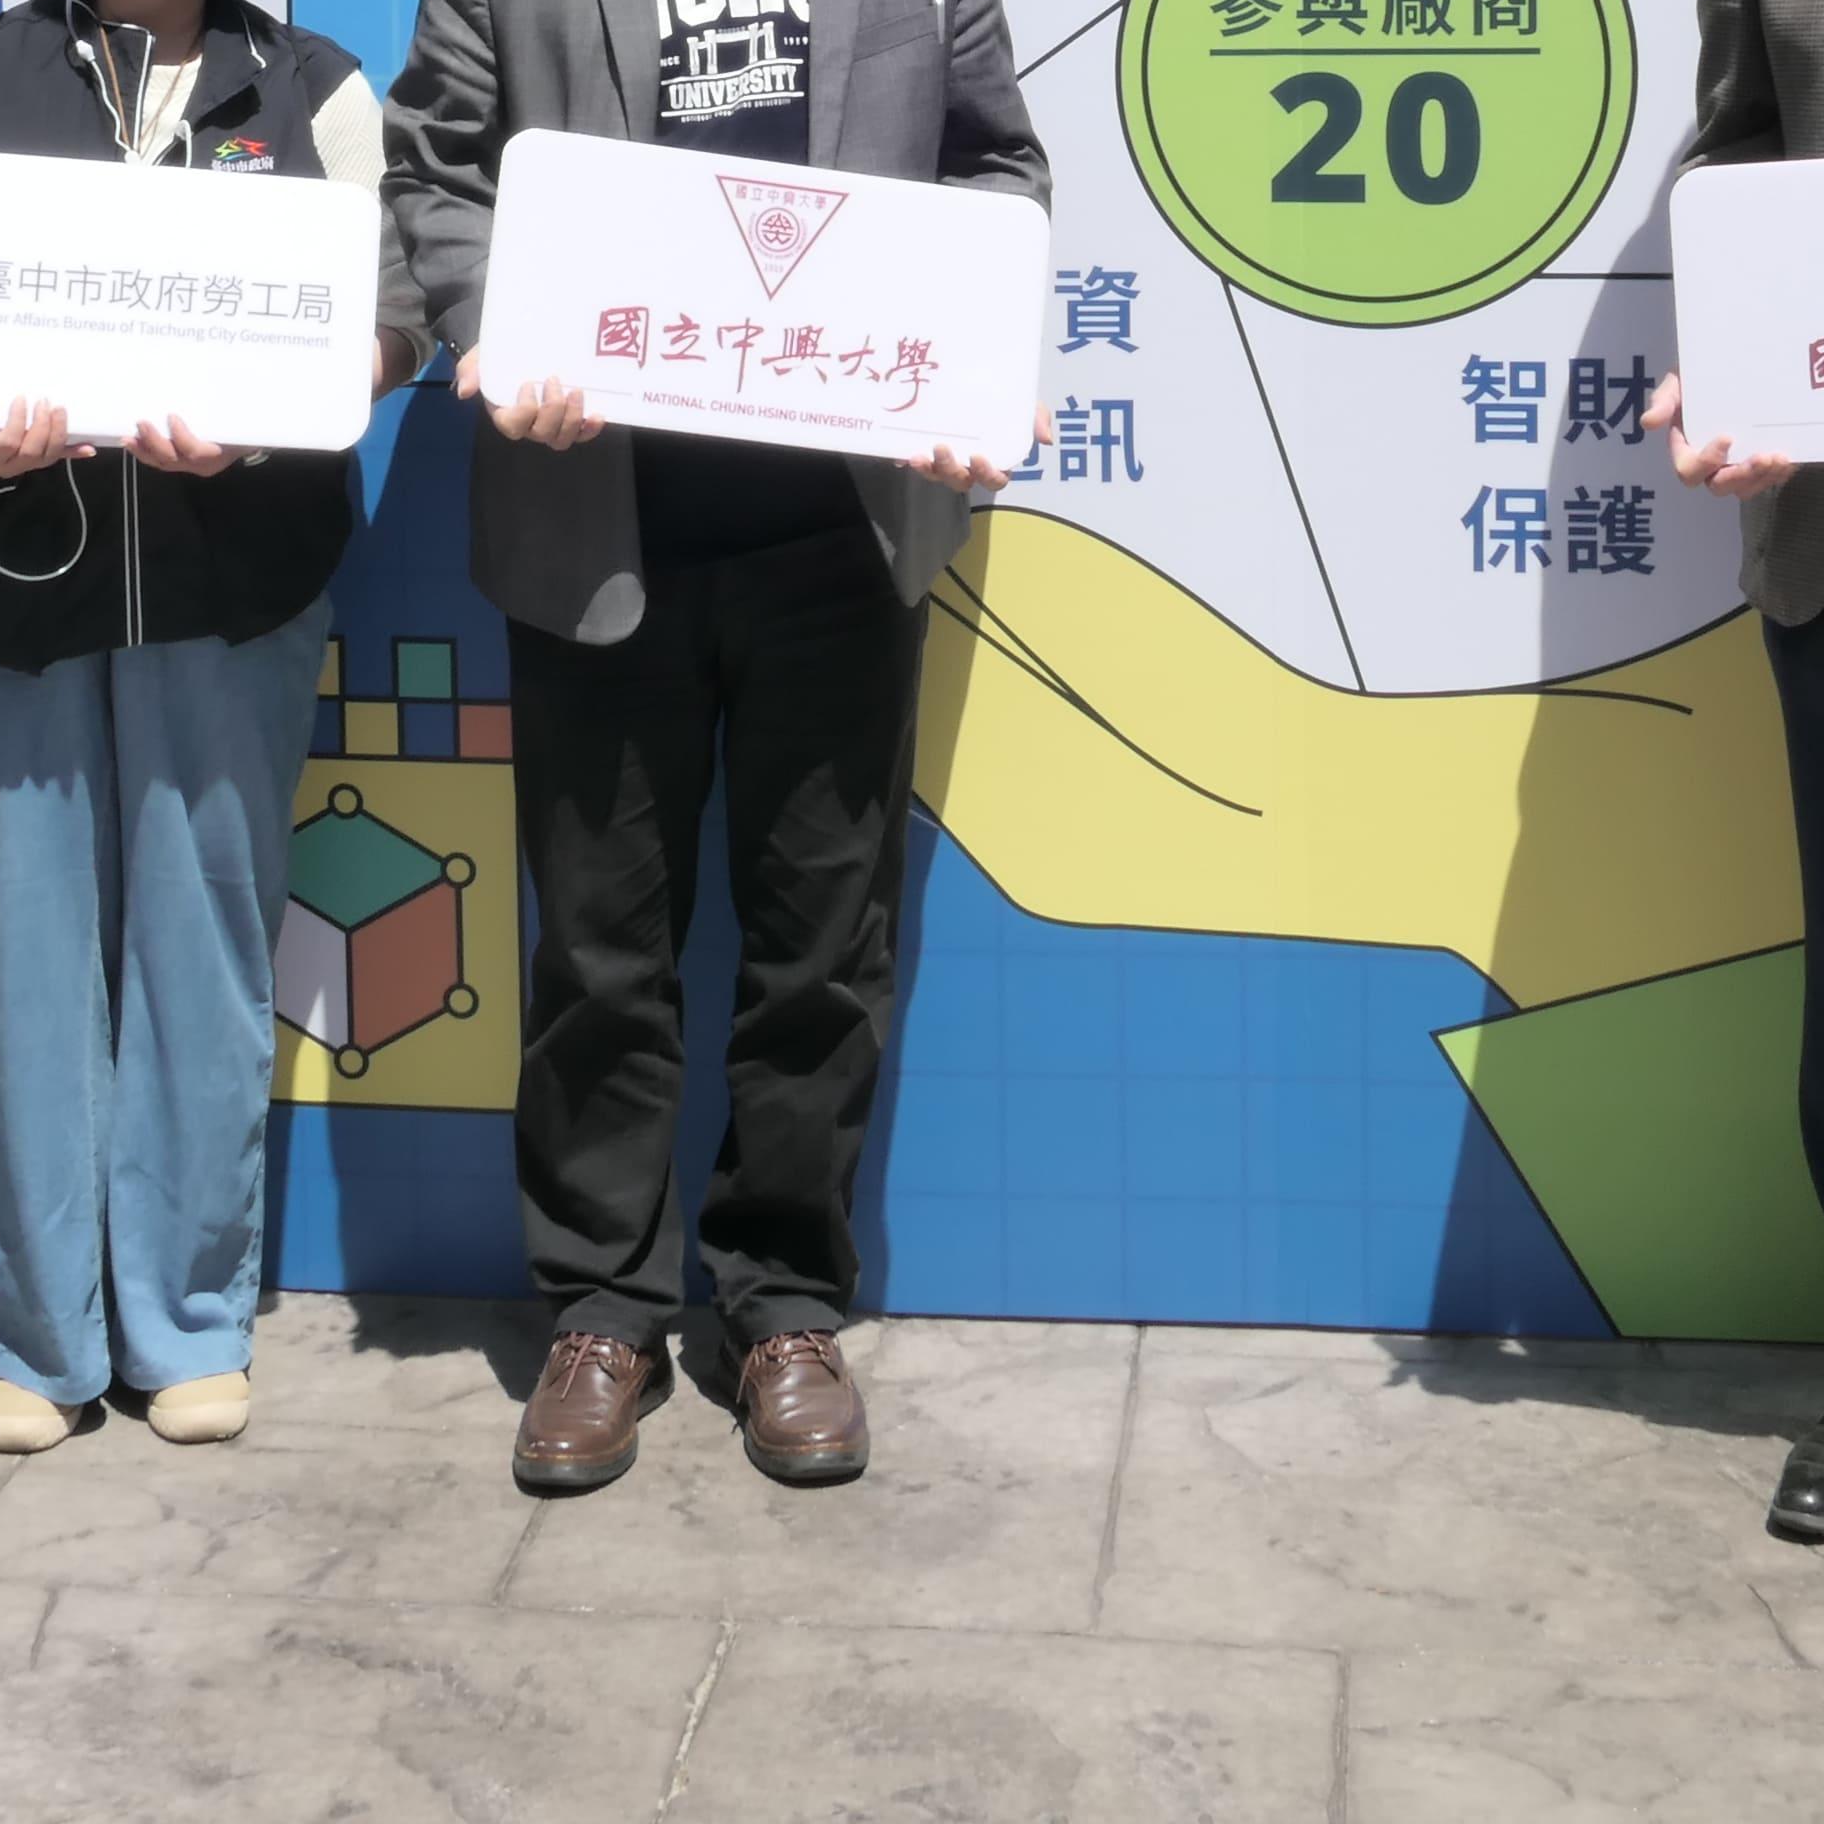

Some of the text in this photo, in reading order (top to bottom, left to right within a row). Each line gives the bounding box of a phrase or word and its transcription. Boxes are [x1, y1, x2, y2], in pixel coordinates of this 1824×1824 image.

[669, 65, 797, 109] UNIVERSITY
[1269, 71, 1482, 205] 20
[12, 313, 59, 329] Affairs
[63, 316, 116, 333] Bureau
[119, 319, 136, 334] of
[139, 321, 205, 341] Taichung
[208, 326, 237, 344] City
[239, 330, 330, 349] Government
[595, 306, 939, 413] 國立中興大學
[642, 391, 873, 432] NATIONAL CHUNG HSING UNIVERSITY
[1009, 395, 1144, 483] 訊
[1461, 353, 1655, 445] 智財
[1460, 485, 1656, 576] 保護
